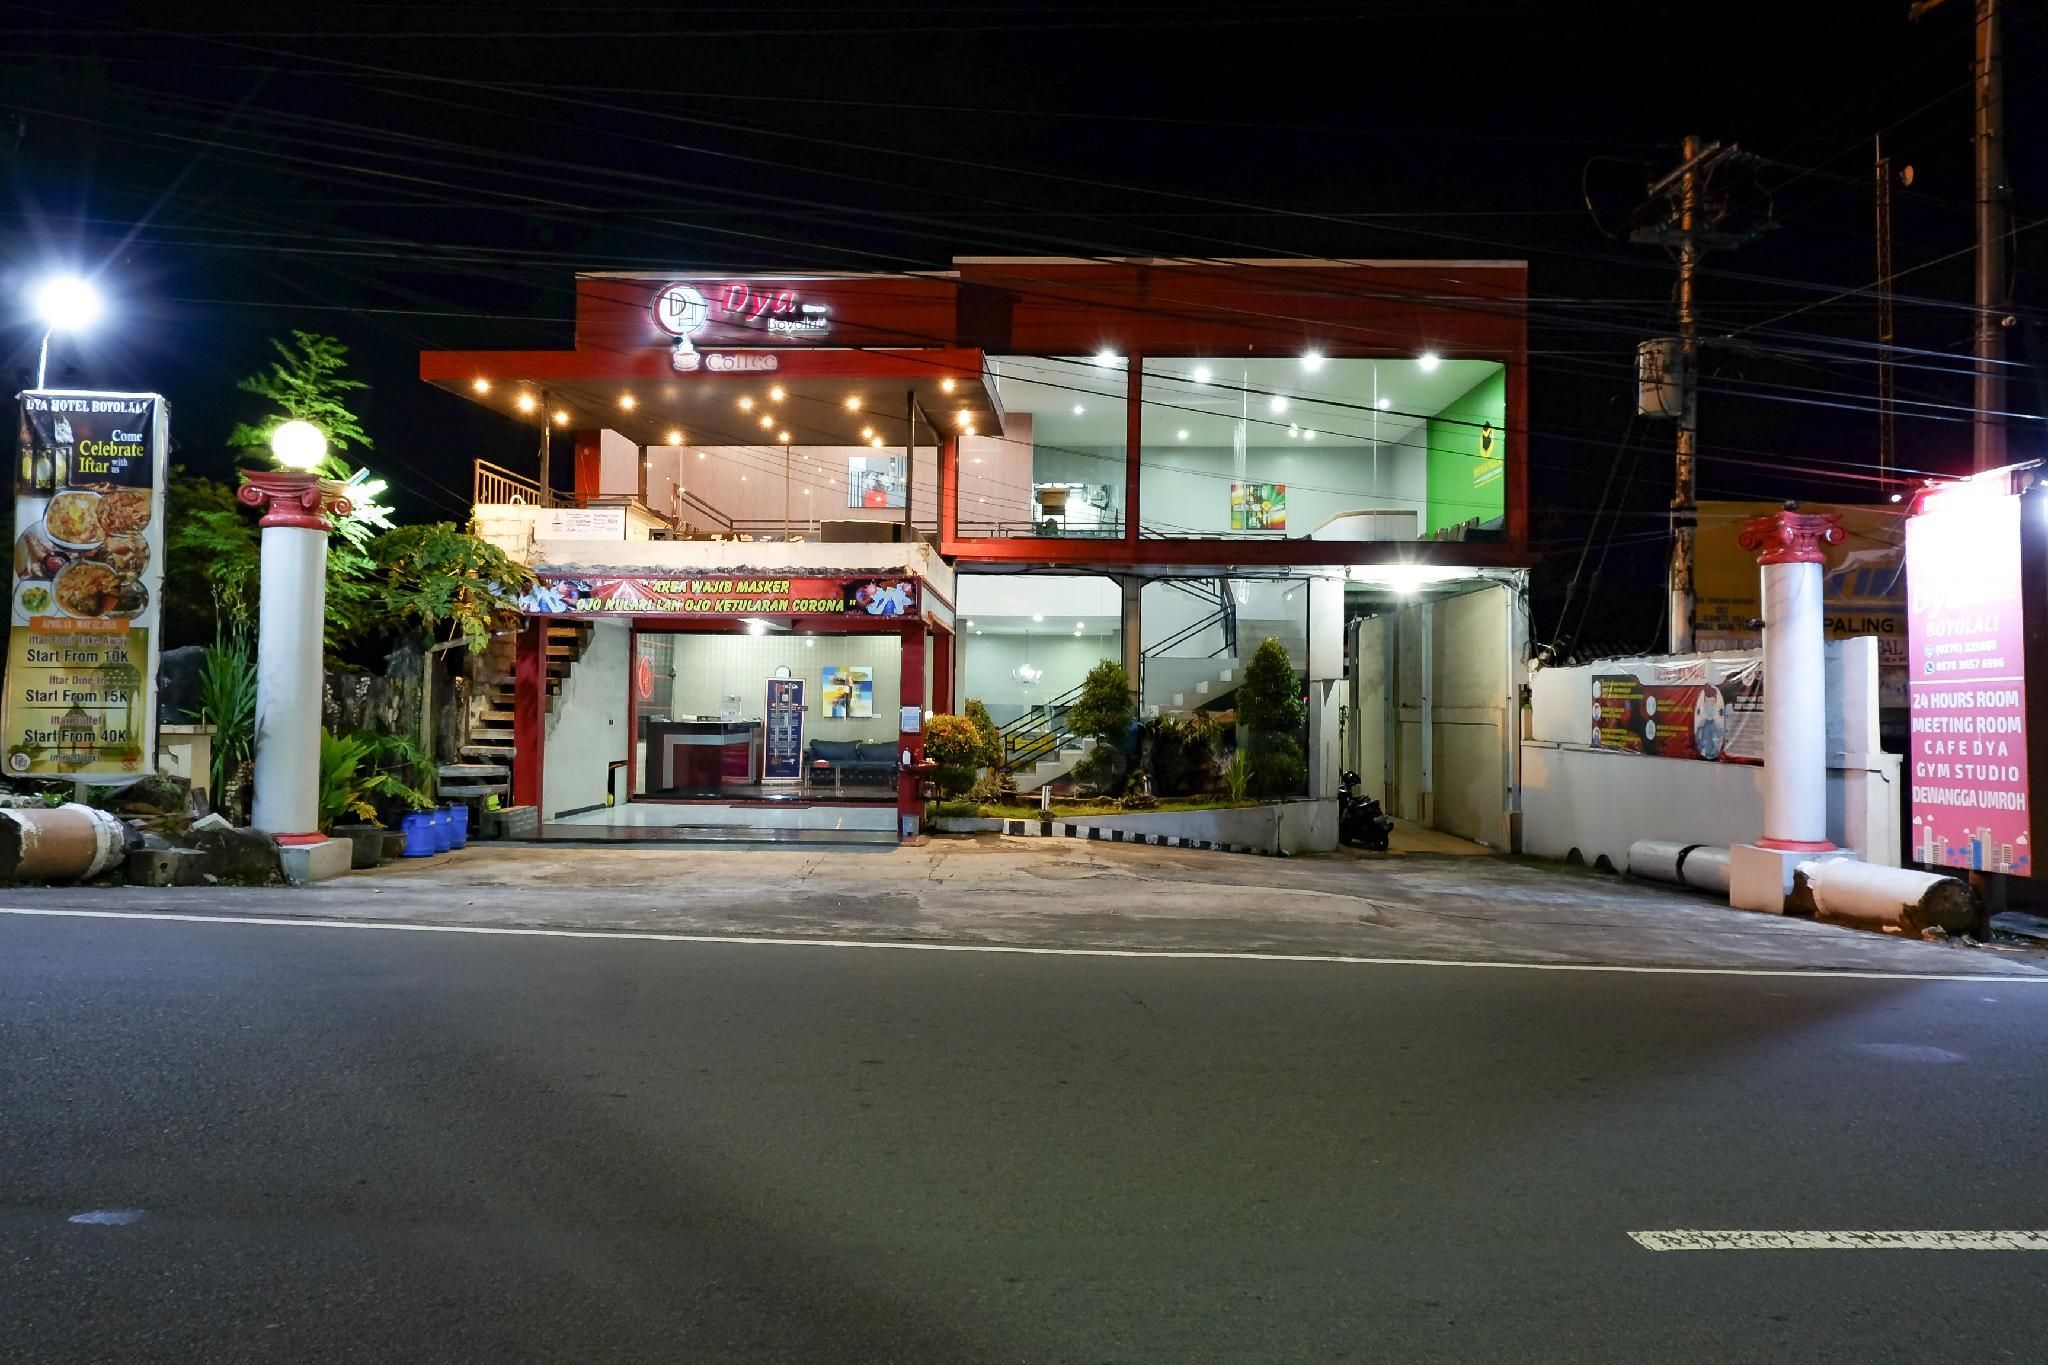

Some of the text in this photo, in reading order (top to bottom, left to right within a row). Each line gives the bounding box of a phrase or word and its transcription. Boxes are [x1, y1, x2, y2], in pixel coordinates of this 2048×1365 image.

[721, 281, 797, 322] Dya
[706, 354, 778, 371] Coffee
[51, 399, 89, 412] HOTEL
[112, 430, 143, 442] Come
[79, 440, 144, 456] Celebrate
[79, 457, 128, 473] Iftar with
[652, 580, 688, 594] AREA
[691, 580, 733, 594] WAJIB
[735, 580, 790, 594] MASKER
[656, 599, 682, 612] LAN
[684, 599, 711, 612] OJO
[714, 599, 789, 613] KETULARAN
[791, 599, 845, 613] CORONA
[1824, 617, 1895, 633] PALING
[27, 649, 129, 662] Start From 10K
[25, 689, 128, 702] Start From 15K
[1913, 690, 2019, 709] 24 HOURS ROOM
[1912, 716, 2022, 734] MEETING ROOM
[24, 729, 127, 742] Start From 40K
[1916, 761, 2019, 782] GYM STUDIO
[1912, 786, 2026, 811] DEWANGGA UMROH
